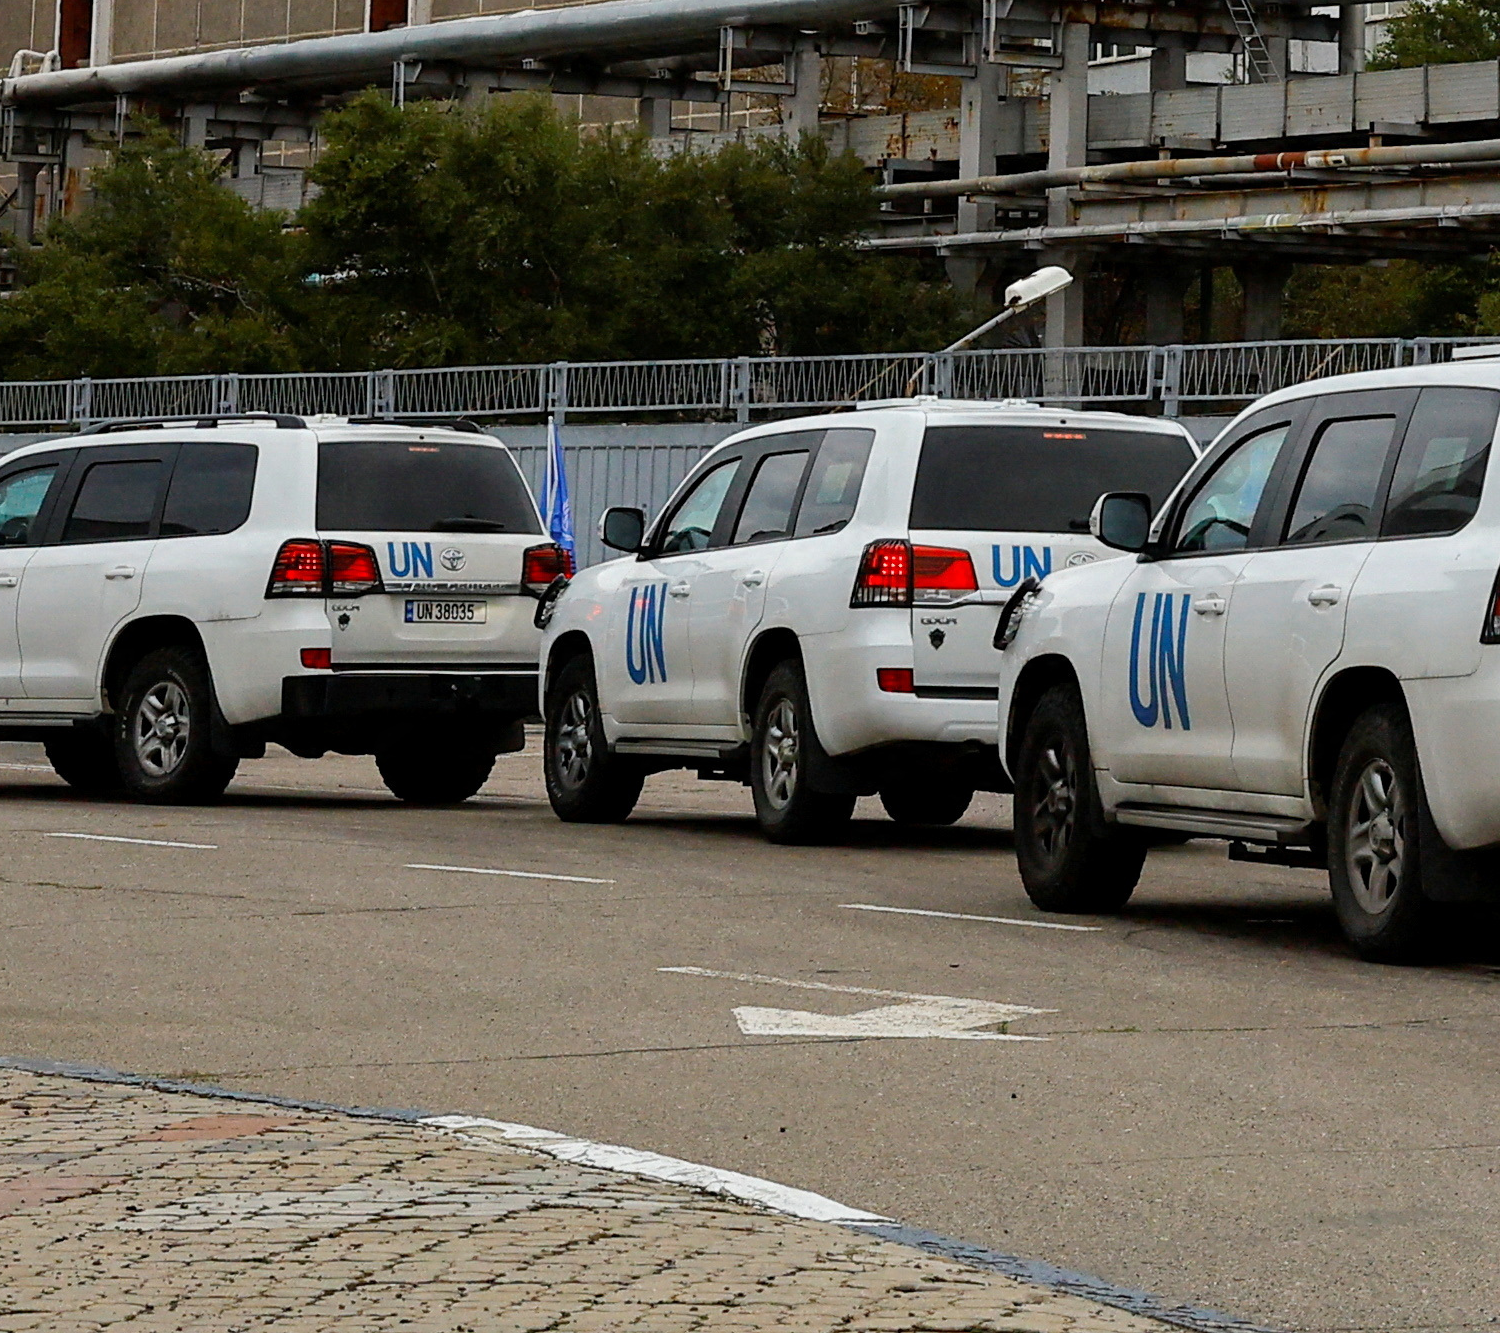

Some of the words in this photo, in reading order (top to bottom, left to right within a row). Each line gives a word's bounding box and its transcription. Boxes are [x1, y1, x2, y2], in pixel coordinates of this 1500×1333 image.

[387, 541, 434, 578] UN
[991, 544, 1053, 587] UN
[416, 603, 433, 620] UN
[626, 582, 668, 685] UN
[1129, 592, 1191, 730] UN
